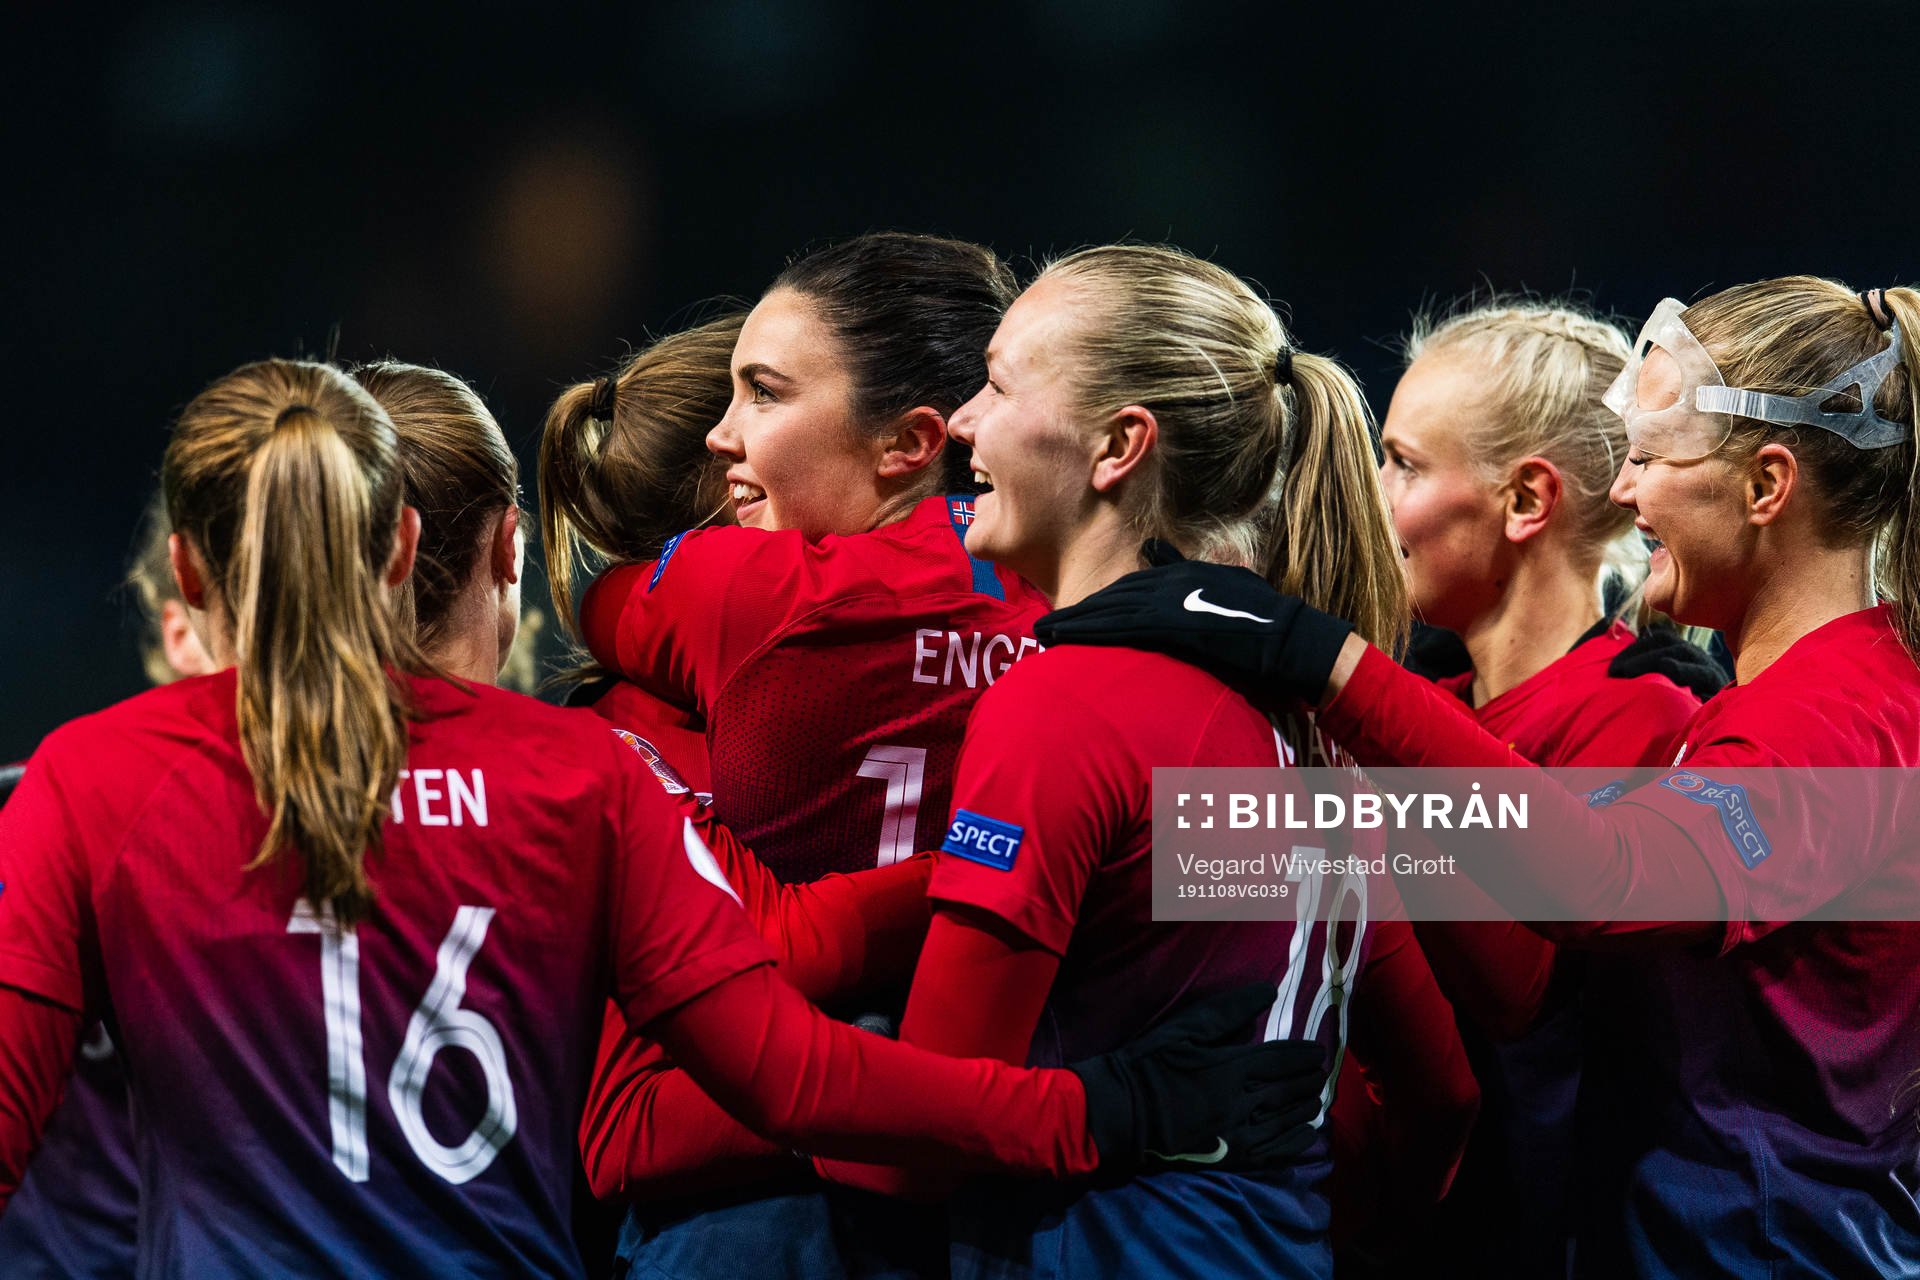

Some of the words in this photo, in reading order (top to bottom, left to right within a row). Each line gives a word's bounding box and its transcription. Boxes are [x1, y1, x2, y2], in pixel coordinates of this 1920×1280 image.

[948, 821, 1020, 858] SPECT
[1700, 786, 1766, 858] RESPECT
[285, 898, 518, 1185] 16
